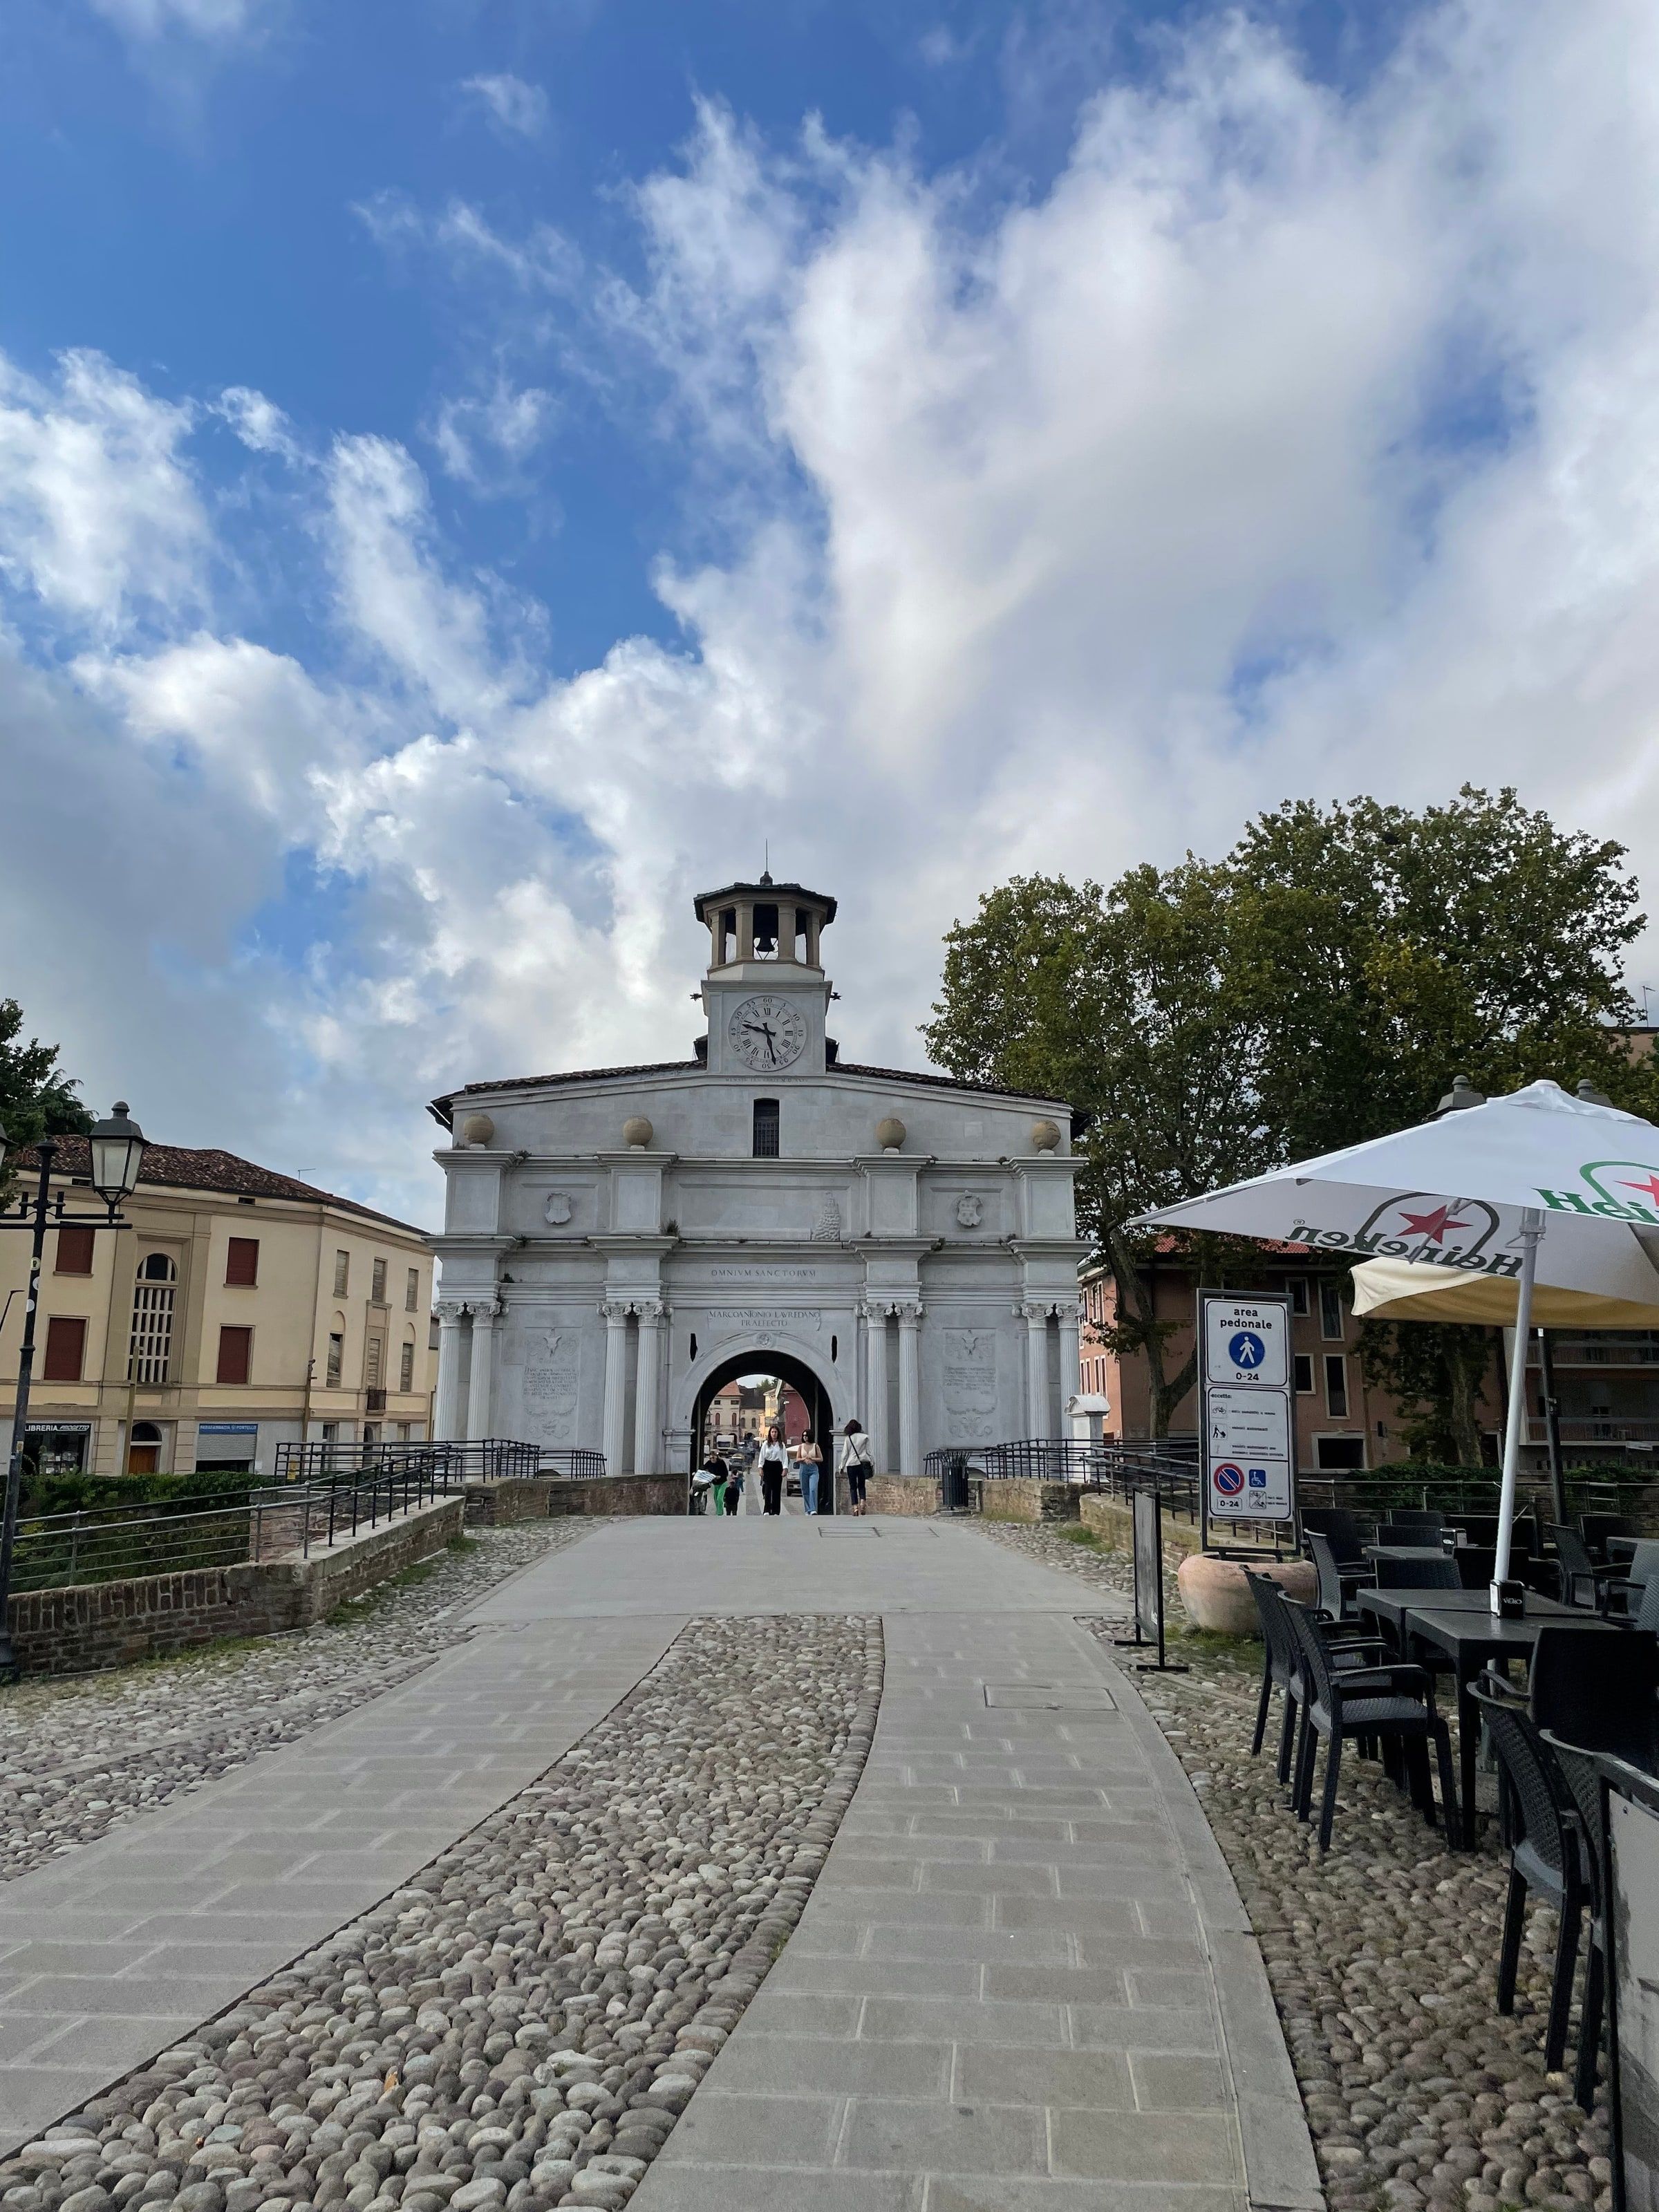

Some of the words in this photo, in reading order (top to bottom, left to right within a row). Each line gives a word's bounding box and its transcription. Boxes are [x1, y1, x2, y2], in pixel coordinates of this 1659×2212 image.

[755, 1269, 816, 1277] SANCTORVM
[1234, 1309, 1258, 1317] area
[1220, 1318, 1273, 1329] pedonale
[1236, 1372, 1259, 1381] 0-24
